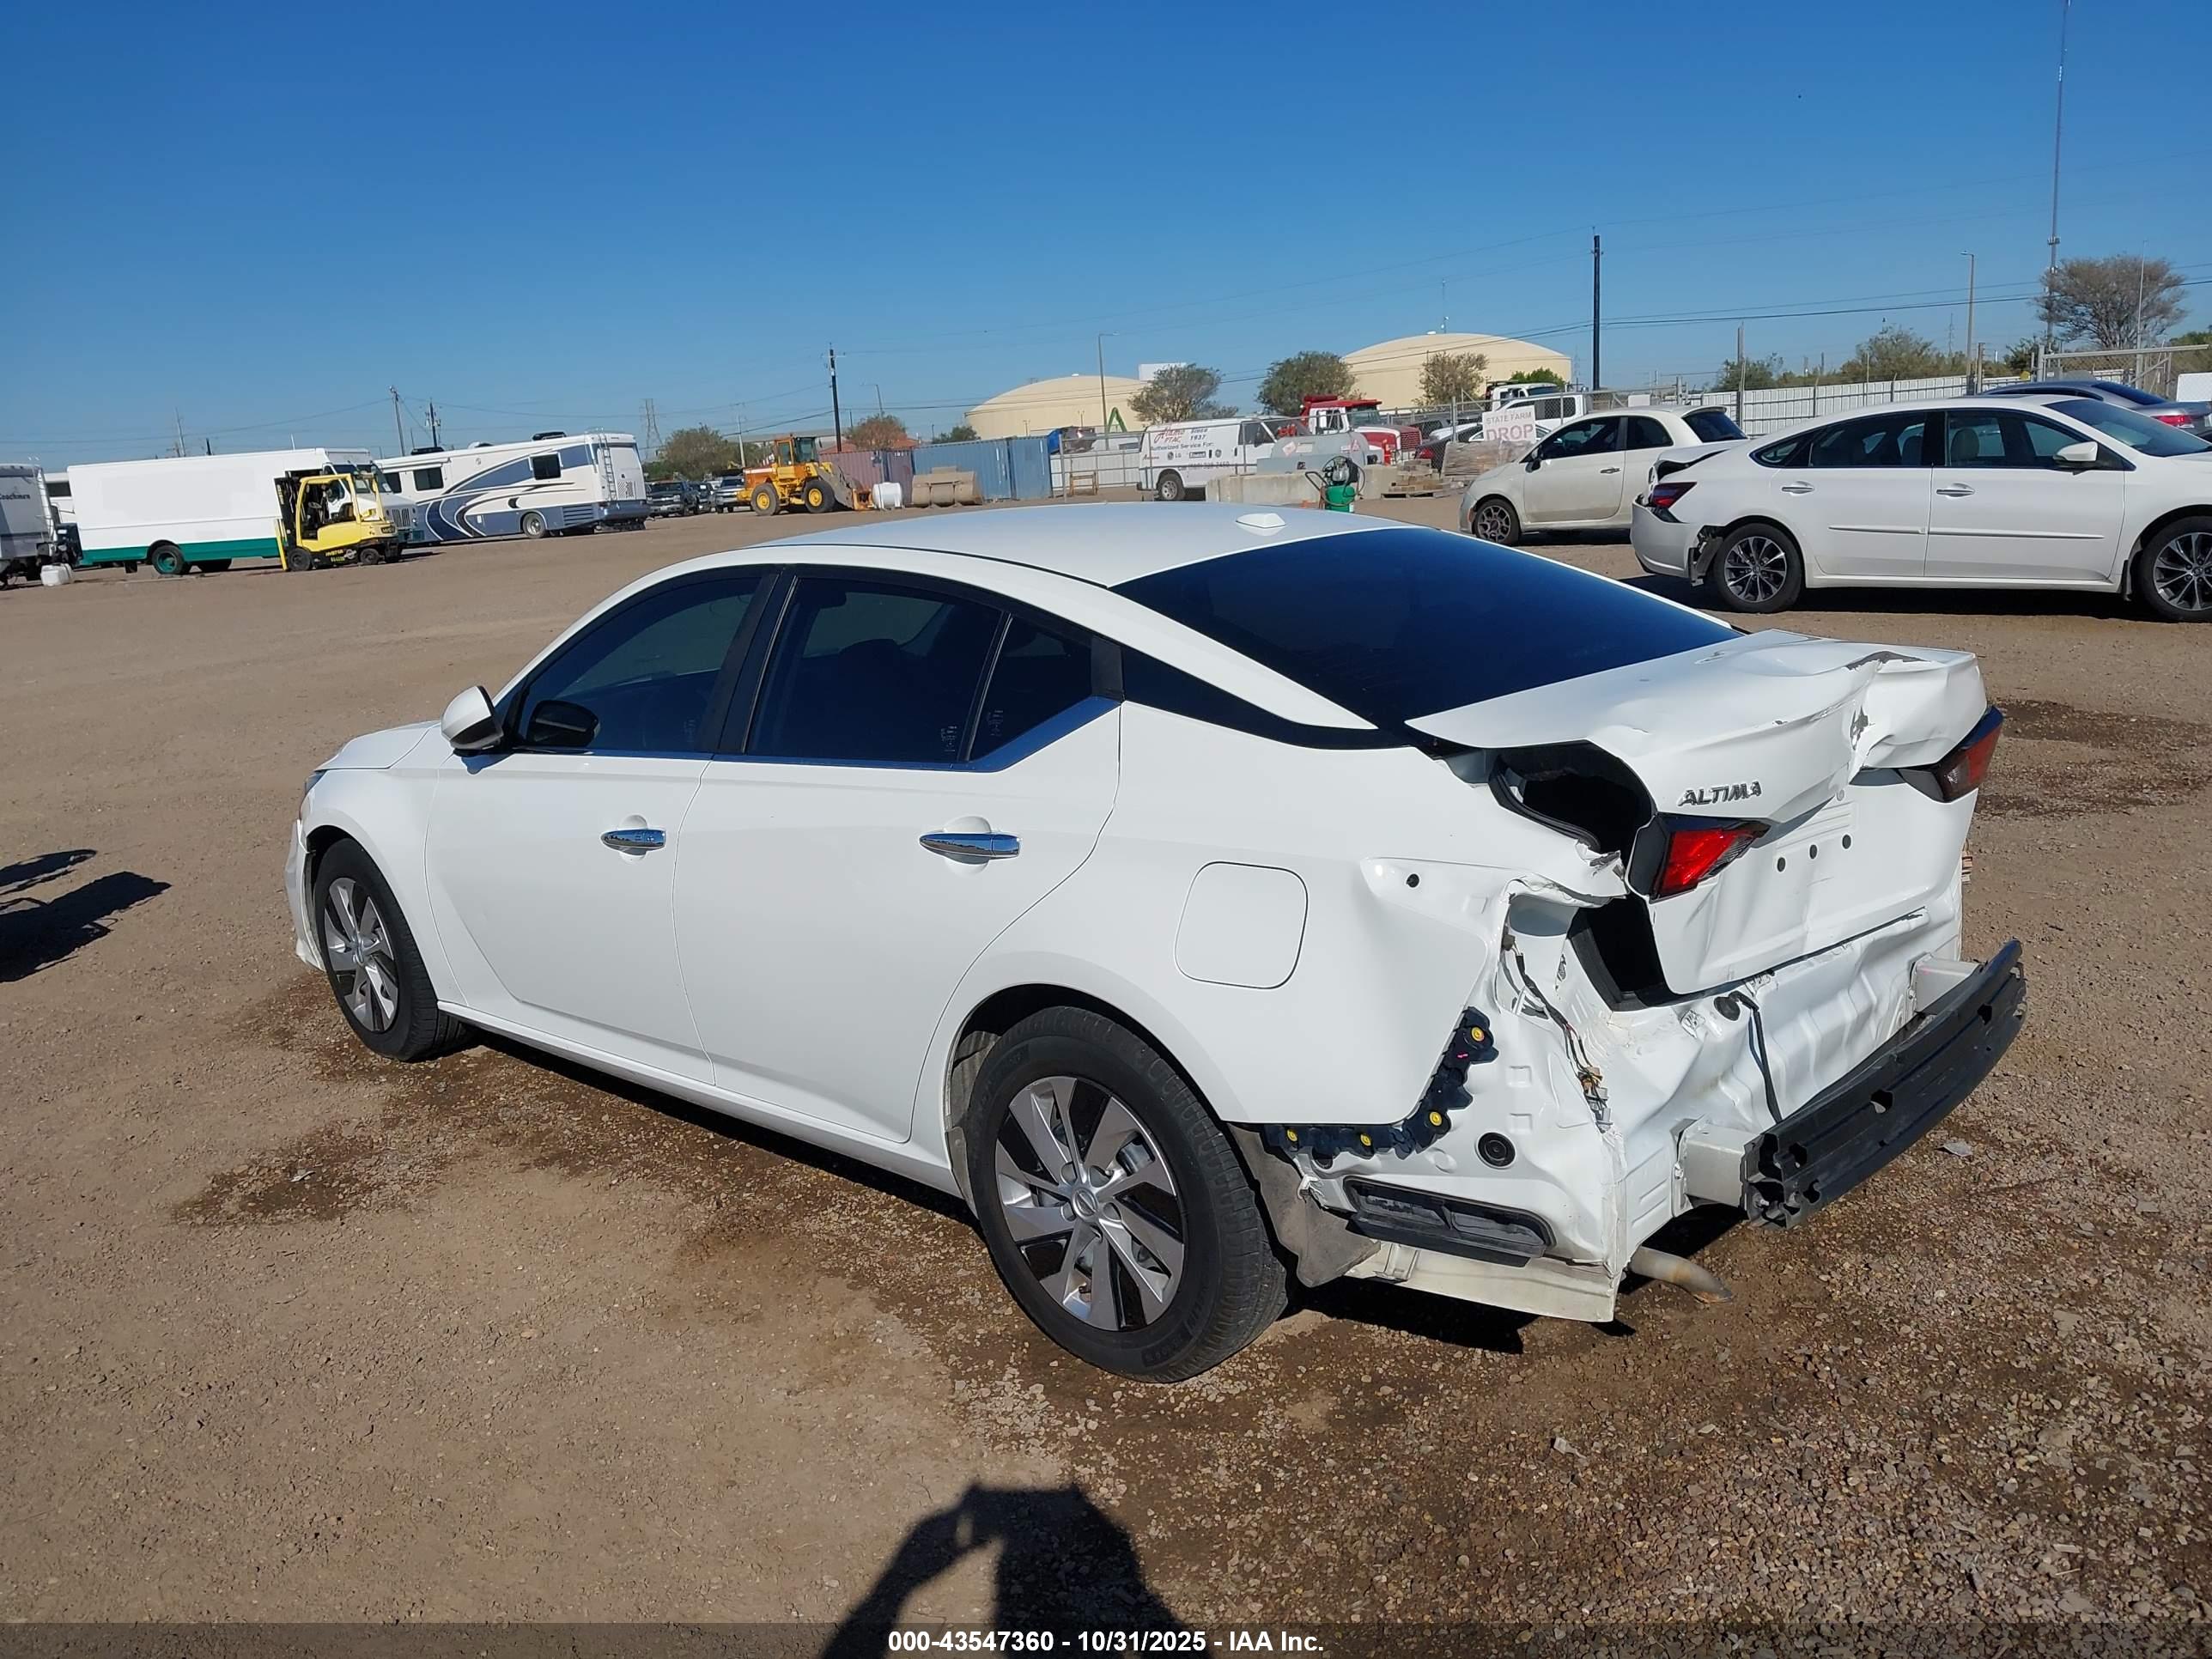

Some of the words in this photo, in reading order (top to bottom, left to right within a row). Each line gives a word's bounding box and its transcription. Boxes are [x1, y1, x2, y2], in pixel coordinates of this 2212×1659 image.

[1486, 415, 1509, 424] STATE
[1510, 411, 1531, 421] FARM
[1486, 424, 1534, 440] DROP
[1678, 781, 1761, 806] ALTIMA
